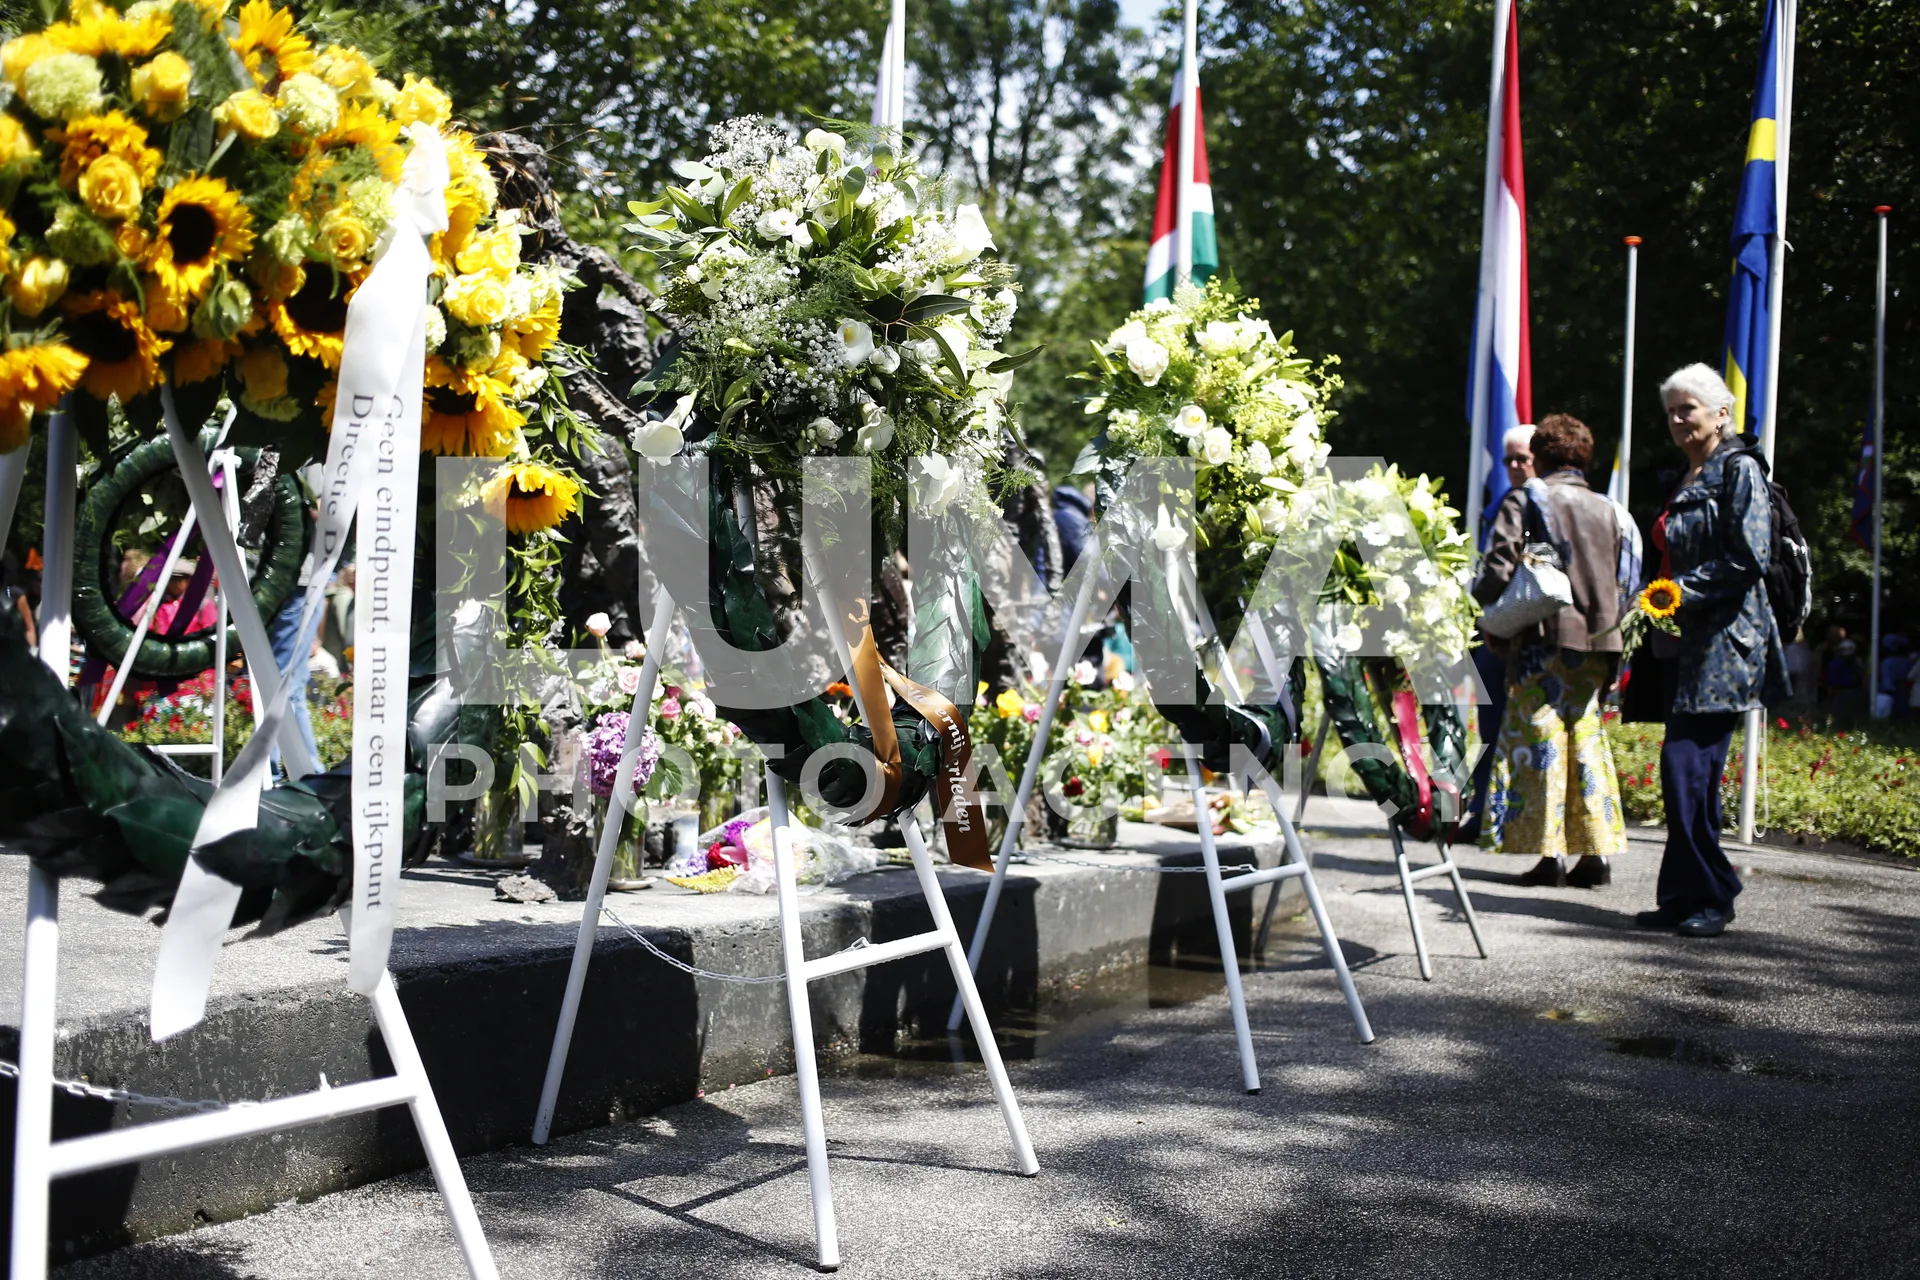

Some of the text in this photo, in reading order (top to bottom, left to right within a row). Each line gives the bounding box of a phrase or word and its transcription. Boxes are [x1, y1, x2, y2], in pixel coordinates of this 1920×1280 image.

[326, 394, 374, 516] Directie
[368, 487, 400, 634] eindpunt,
[370, 646, 388, 724] maar
[368, 735, 385, 788] een
[363, 801, 390, 911] ijkpunt
